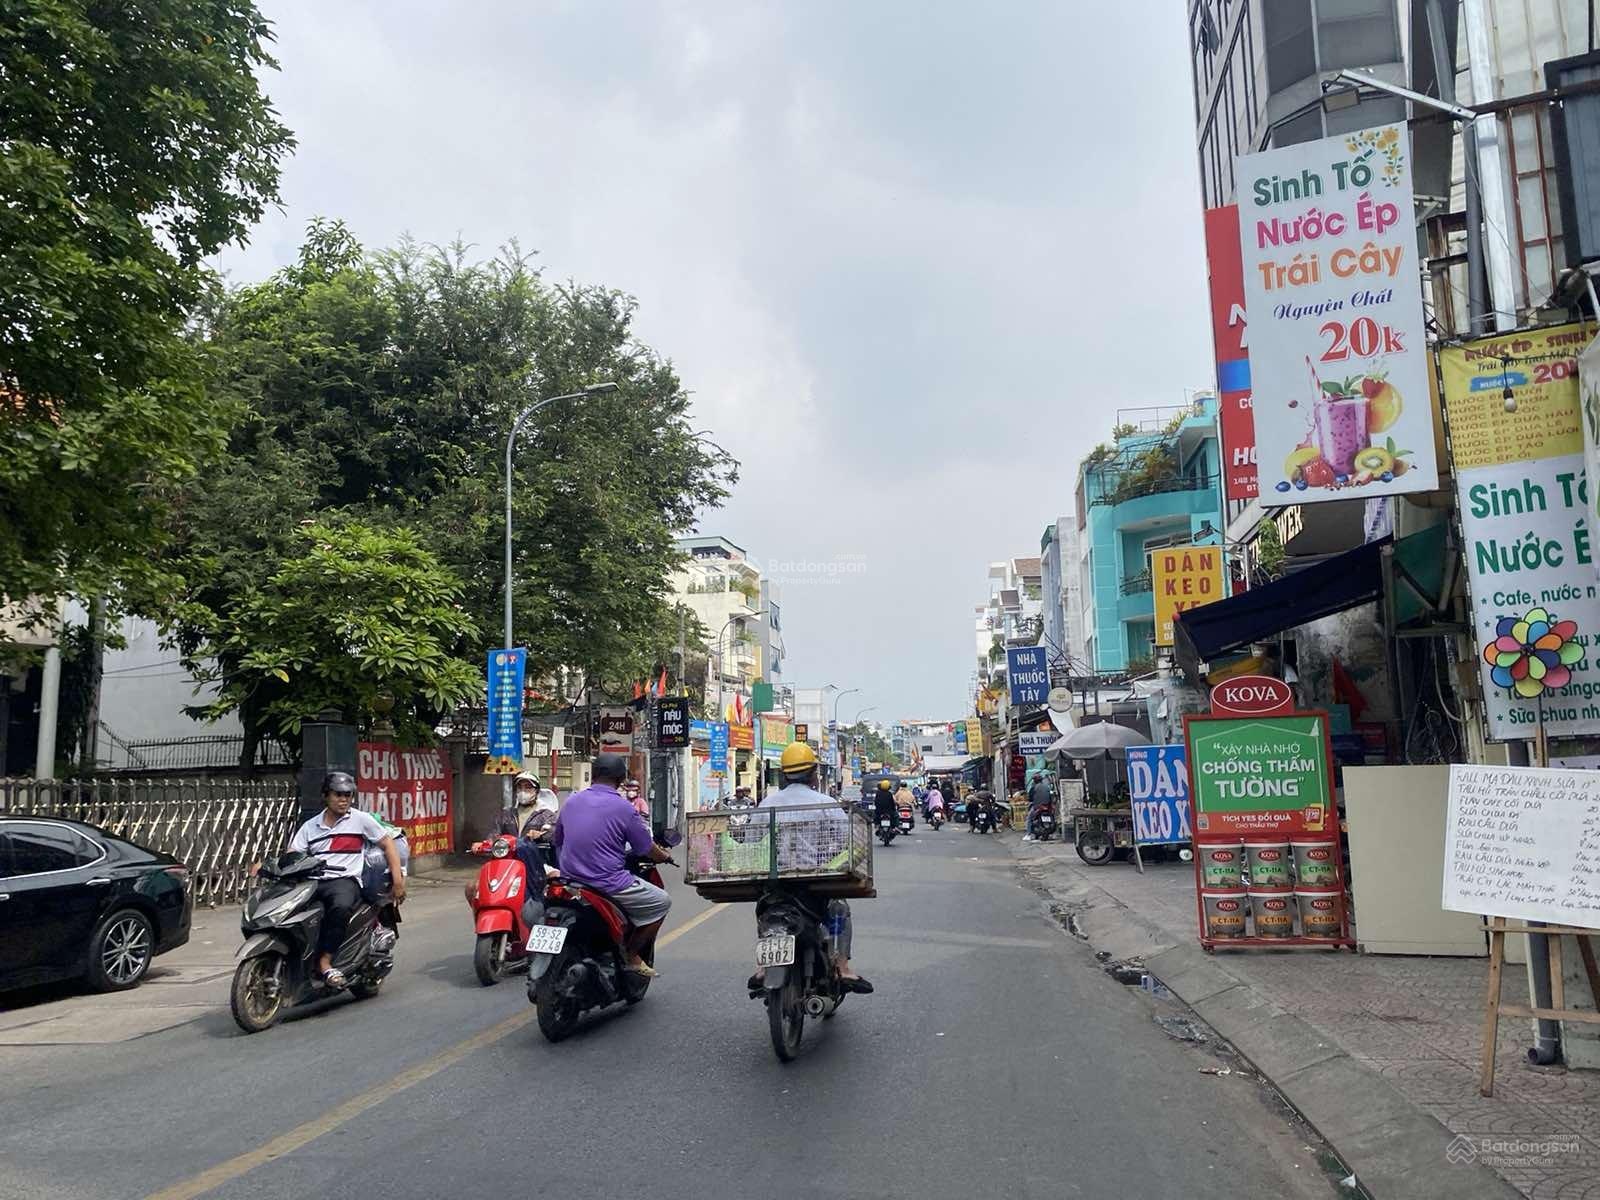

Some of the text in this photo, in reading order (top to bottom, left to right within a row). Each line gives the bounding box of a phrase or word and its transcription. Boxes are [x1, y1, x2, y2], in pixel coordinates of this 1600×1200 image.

[1253, 150, 1375, 206] Sinh Tố
[1256, 192, 1398, 249] Nước Ép
[1258, 243, 1402, 290] Trái Cây
[1274, 289, 1393, 320] Nguyên Chất
[1469, 478, 1547, 520] Sinh
[1475, 518, 1592, 574] Nước É
[1165, 552, 1212, 573] DÁN
[1166, 577, 1211, 595] KEO
[1493, 590, 1537, 606] Cafe,
[1541, 584, 1581, 601] nước
[1016, 652, 1037, 666] NHÀ
[1012, 667, 1046, 685] THUỐC
[1020, 686, 1040, 702] TÂY
[1225, 686, 1279, 703] KOVA
[1508, 707, 1536, 724] Sữa
[1541, 704, 1577, 721] chua
[608, 721, 626, 731] 24H
[1021, 735, 1034, 745] NHÀ
[1246, 741, 1272, 755] NHÀ
[359, 749, 445, 780] CHO THUÊ
[1202, 754, 1315, 775] CHỐNG THẤM
[1134, 800, 1172, 839] KEO
[1222, 813, 1240, 822] TÍCH
[1274, 813, 1291, 821] QUÀ
